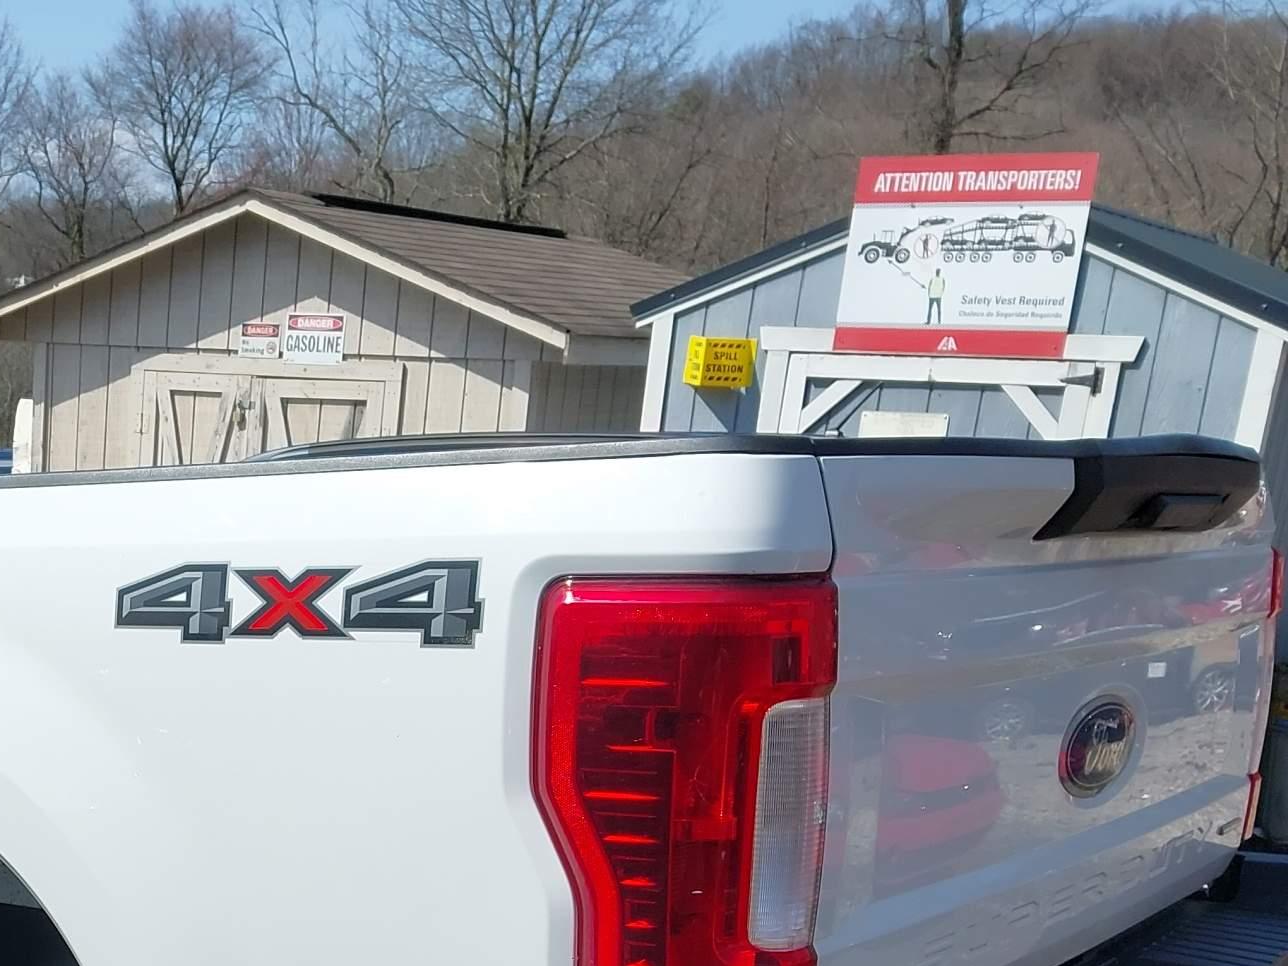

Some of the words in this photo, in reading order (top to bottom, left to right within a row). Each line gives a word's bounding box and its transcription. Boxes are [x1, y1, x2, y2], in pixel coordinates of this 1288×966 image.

[873, 171, 954, 193] ATTENTION
[957, 169, 1082, 192] TRANSPORTERS!
[960, 294, 992, 308] Safety
[995, 295, 1017, 306] Vest
[1019, 295, 1066, 308] Required
[996, 311, 1029, 319] Seguridad
[297, 317, 334, 329] DANGER
[247, 326, 274, 335] DANGER
[286, 335, 342, 353] GASOLINE
[714, 351, 738, 361] SPILL
[705, 364, 743, 373] STATION
